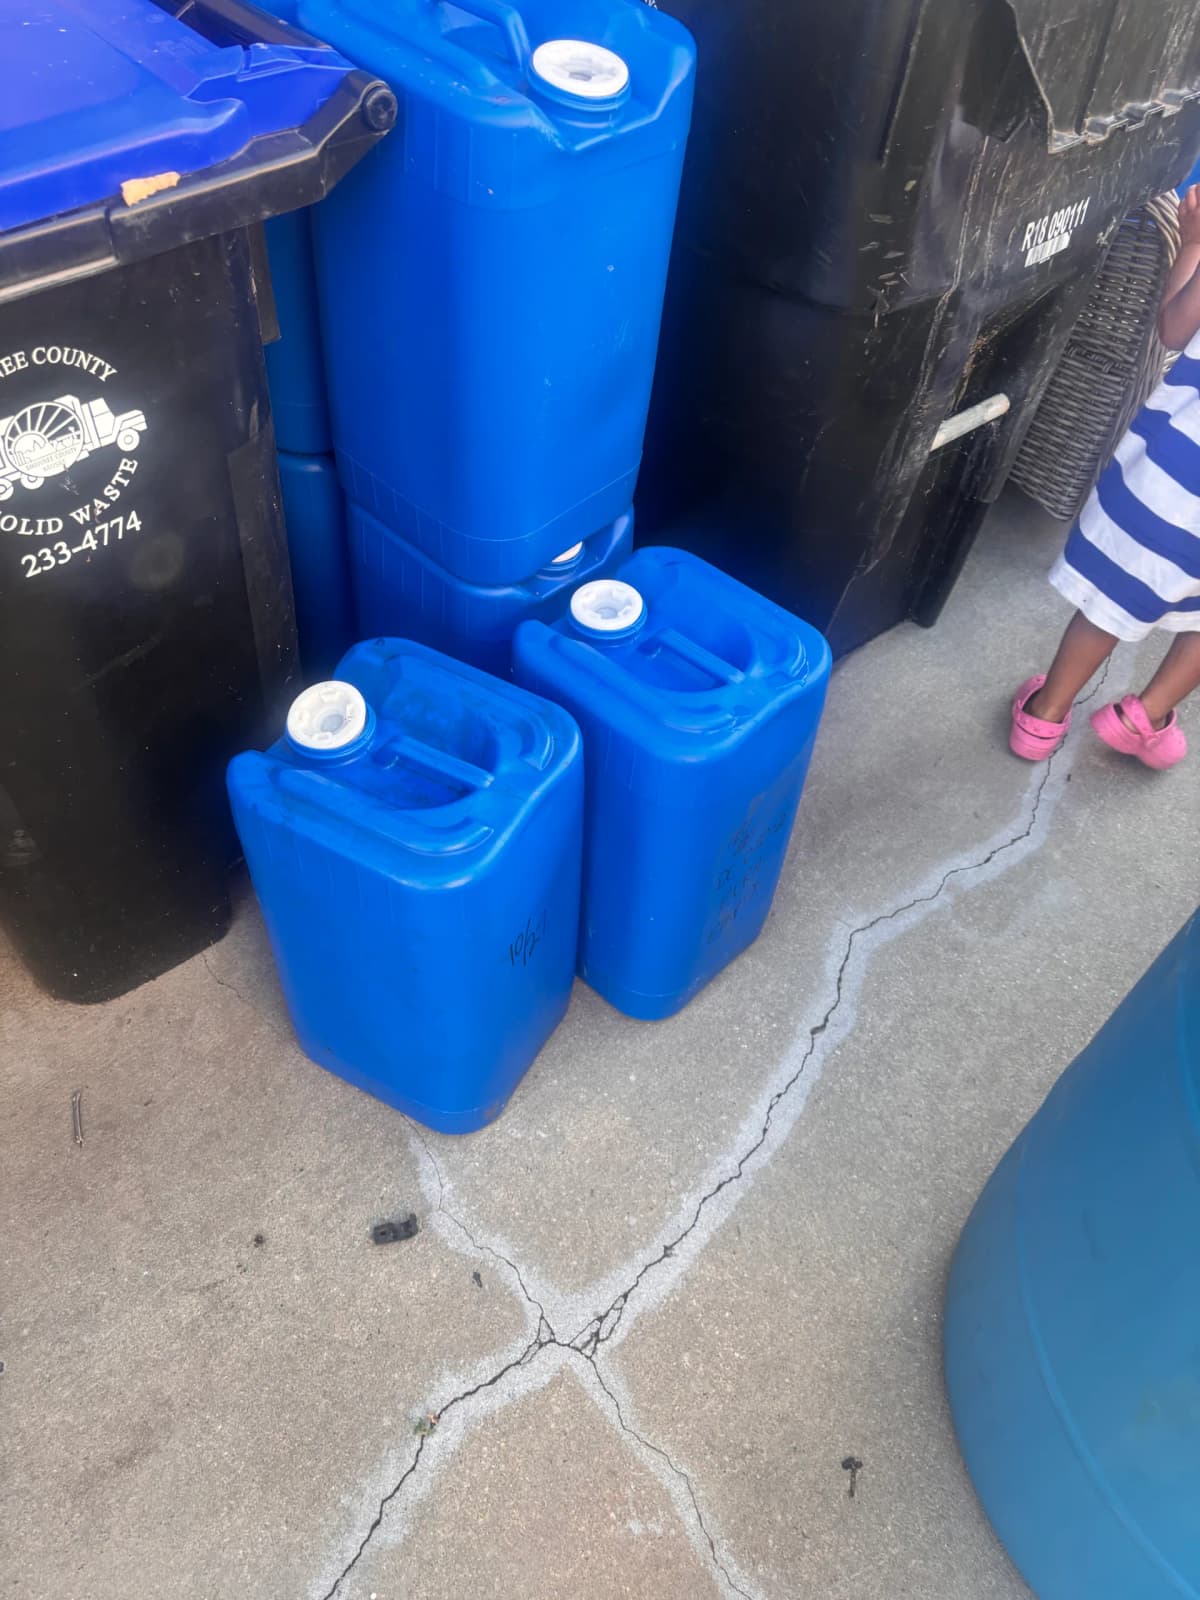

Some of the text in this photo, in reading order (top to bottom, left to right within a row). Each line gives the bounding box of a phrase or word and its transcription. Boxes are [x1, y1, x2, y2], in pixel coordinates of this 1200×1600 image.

[1021, 196, 1091, 252] R18 090111
[0, 346, 118, 382] EE COUNTY
[0, 513, 64, 536] OLID
[69, 457, 138, 525] WASTE
[21, 510, 142, 578] 233-4774
